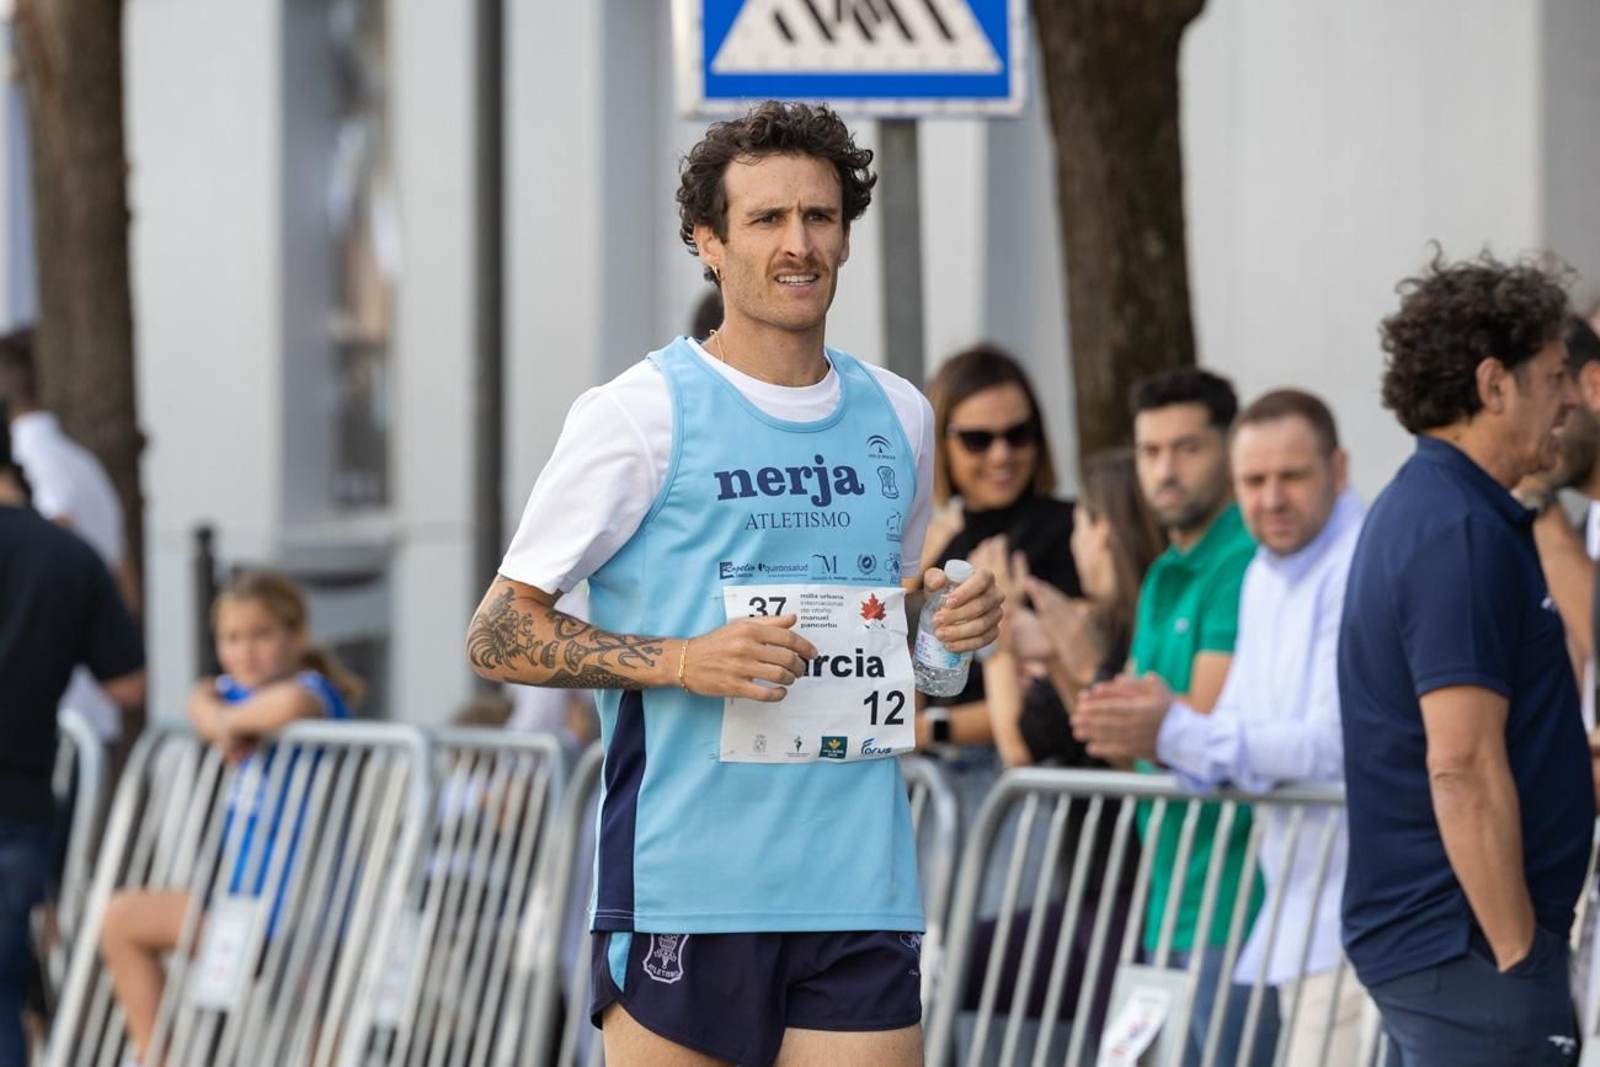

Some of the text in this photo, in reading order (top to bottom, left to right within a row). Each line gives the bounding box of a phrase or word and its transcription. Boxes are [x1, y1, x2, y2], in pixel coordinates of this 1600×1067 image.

[714, 454, 865, 507] nerja
[745, 511, 851, 531] ATLETISMO
[749, 596, 787, 618] 37
[863, 690, 905, 725] 12
